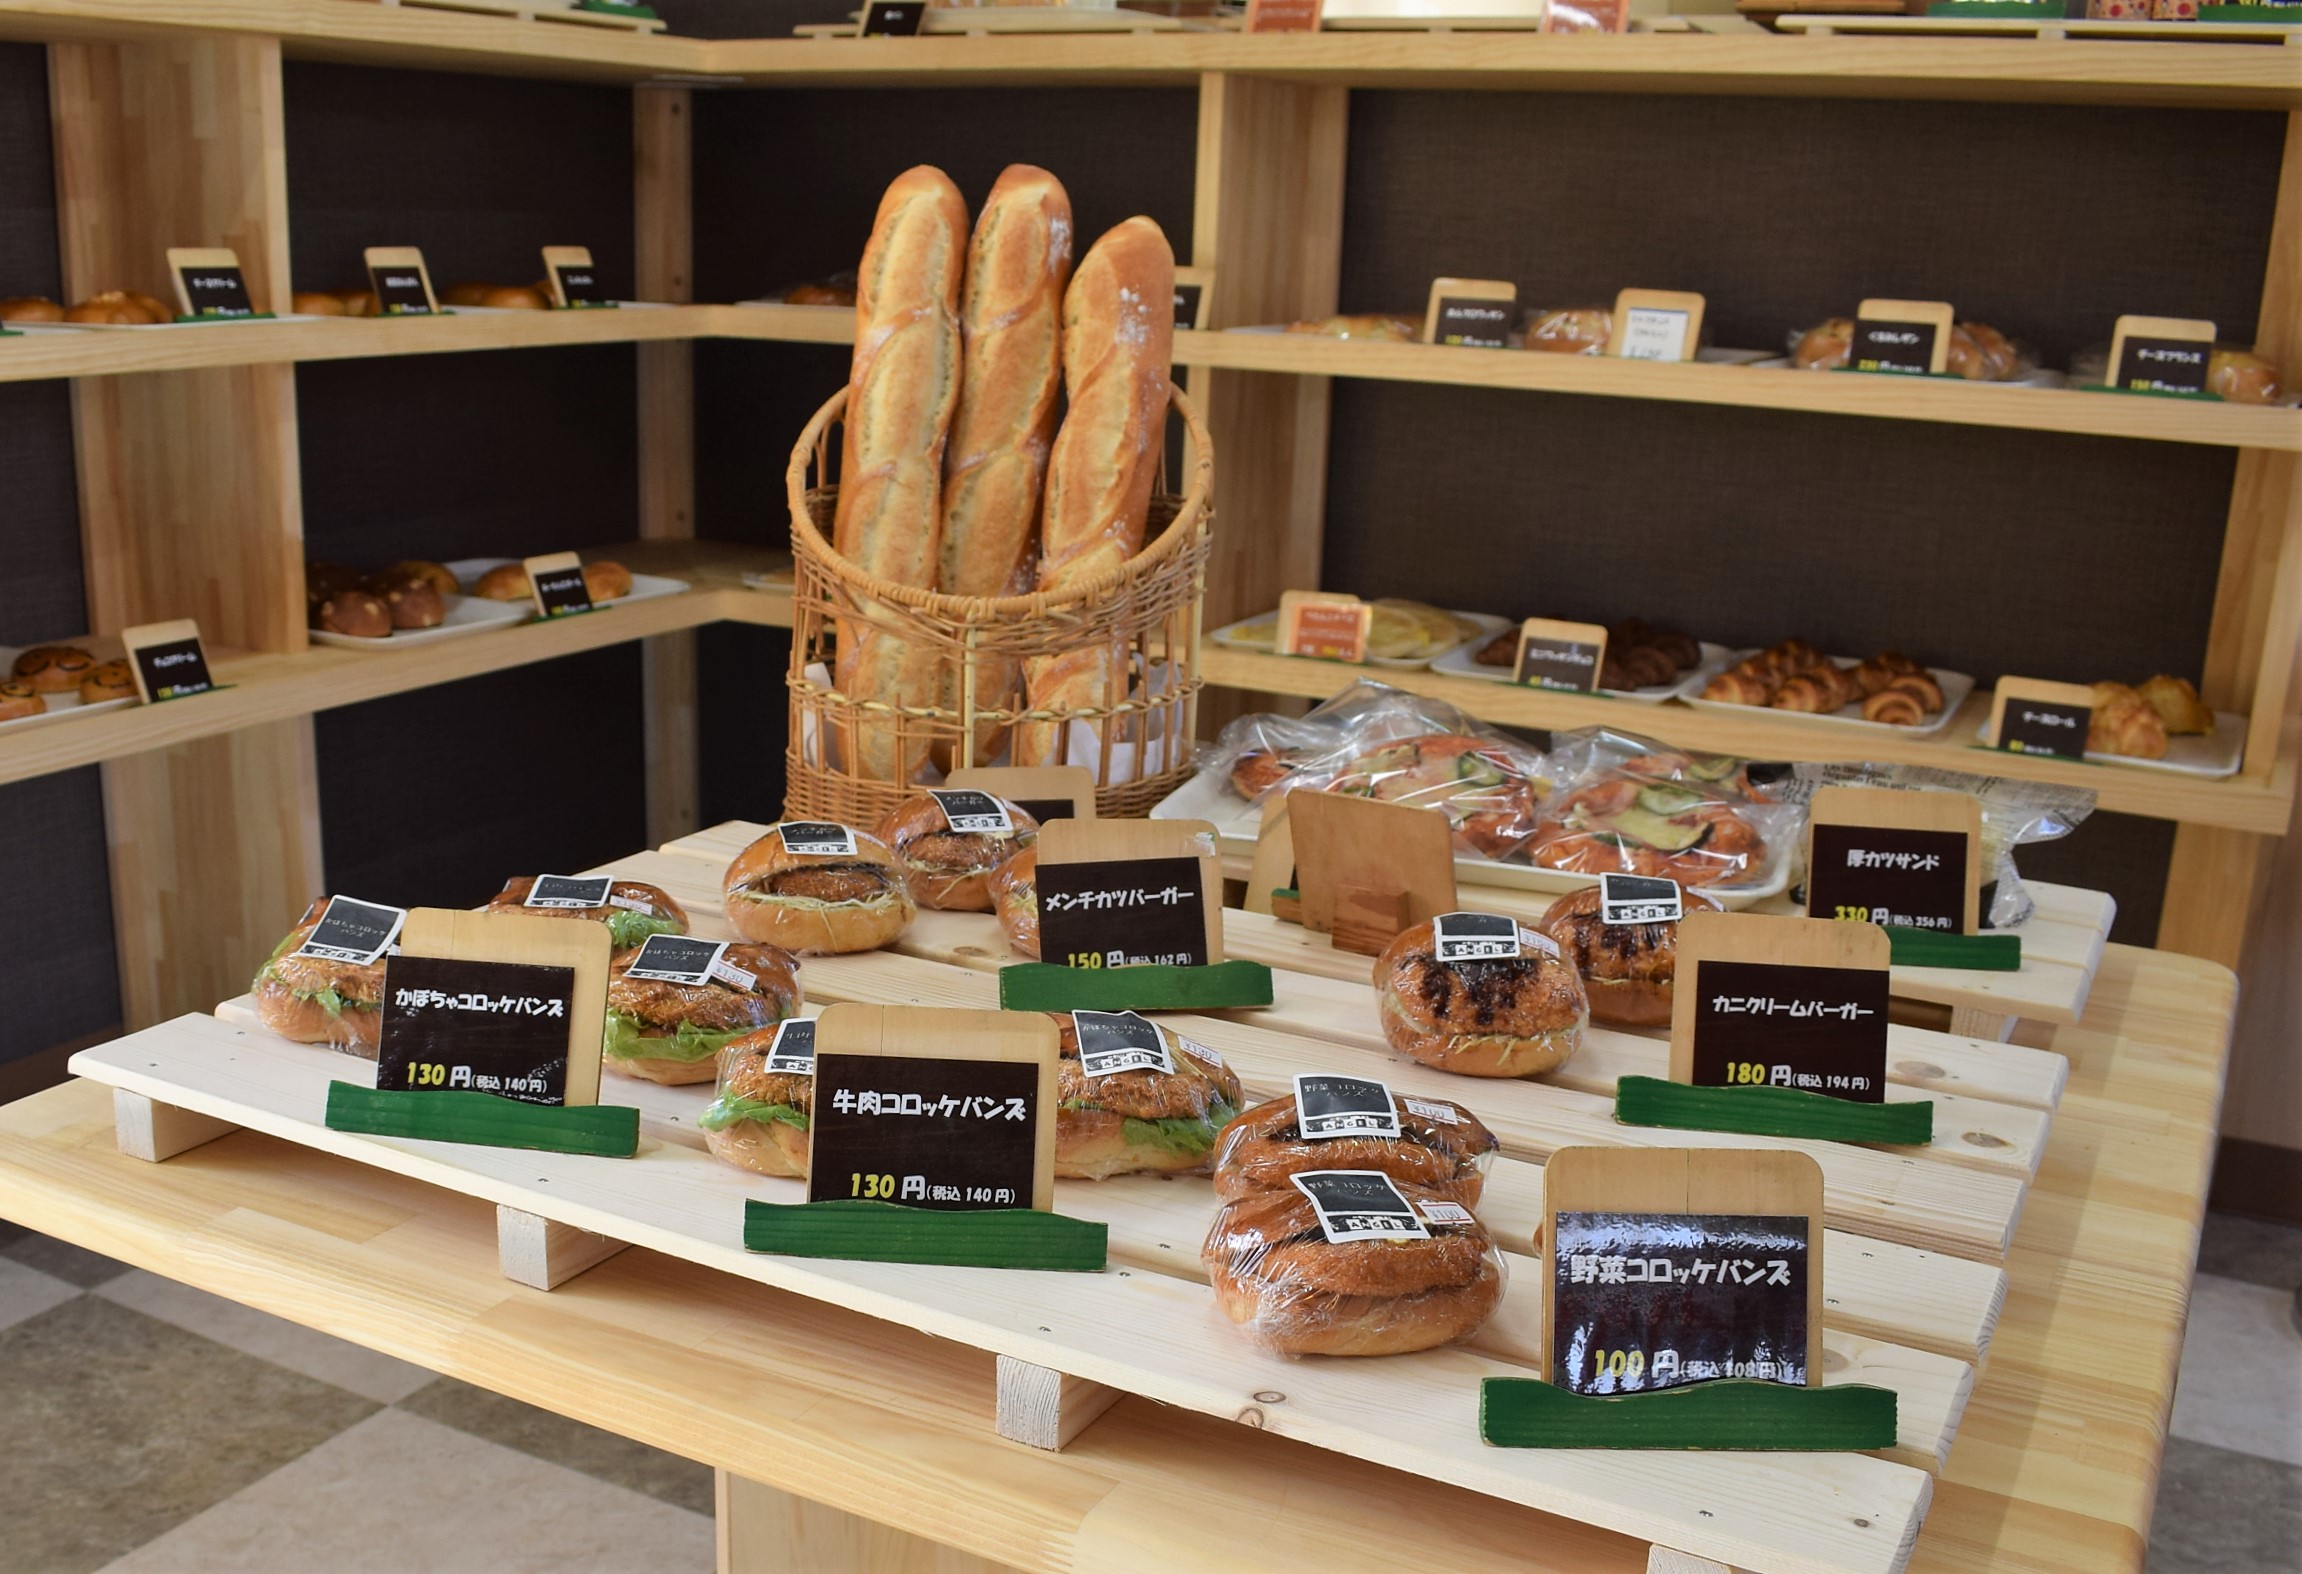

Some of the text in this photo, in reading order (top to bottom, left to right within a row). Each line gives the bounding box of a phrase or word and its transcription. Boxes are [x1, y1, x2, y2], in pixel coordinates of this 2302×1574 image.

[1846, 849, 1940, 871] 厚カツサンド
[1045, 886, 1195, 912] メンチカツバーガー
[1834, 905, 1868, 923] 330
[1068, 952, 1102, 969] 150
[395, 987, 564, 1018] かぼちゃコロッケバンズ
[1712, 995, 1874, 1020] カニクリームバーガー
[407, 1061, 446, 1086] 130
[505, 1077, 529, 1092] 140
[1726, 1061, 1766, 1085] 180
[1826, 1074, 1850, 1090] 194
[832, 1088, 1027, 1122] 牛肉コロッケバンズ
[1324, 1117, 1378, 1130] ANGEL
[851, 1172, 896, 1199] 130
[965, 1186, 992, 1203] 140
[1350, 1219, 1406, 1231] ANGEL
[1570, 1254, 1792, 1287] 野菜コロッケバンズ
[1594, 1349, 1645, 1378] 100
